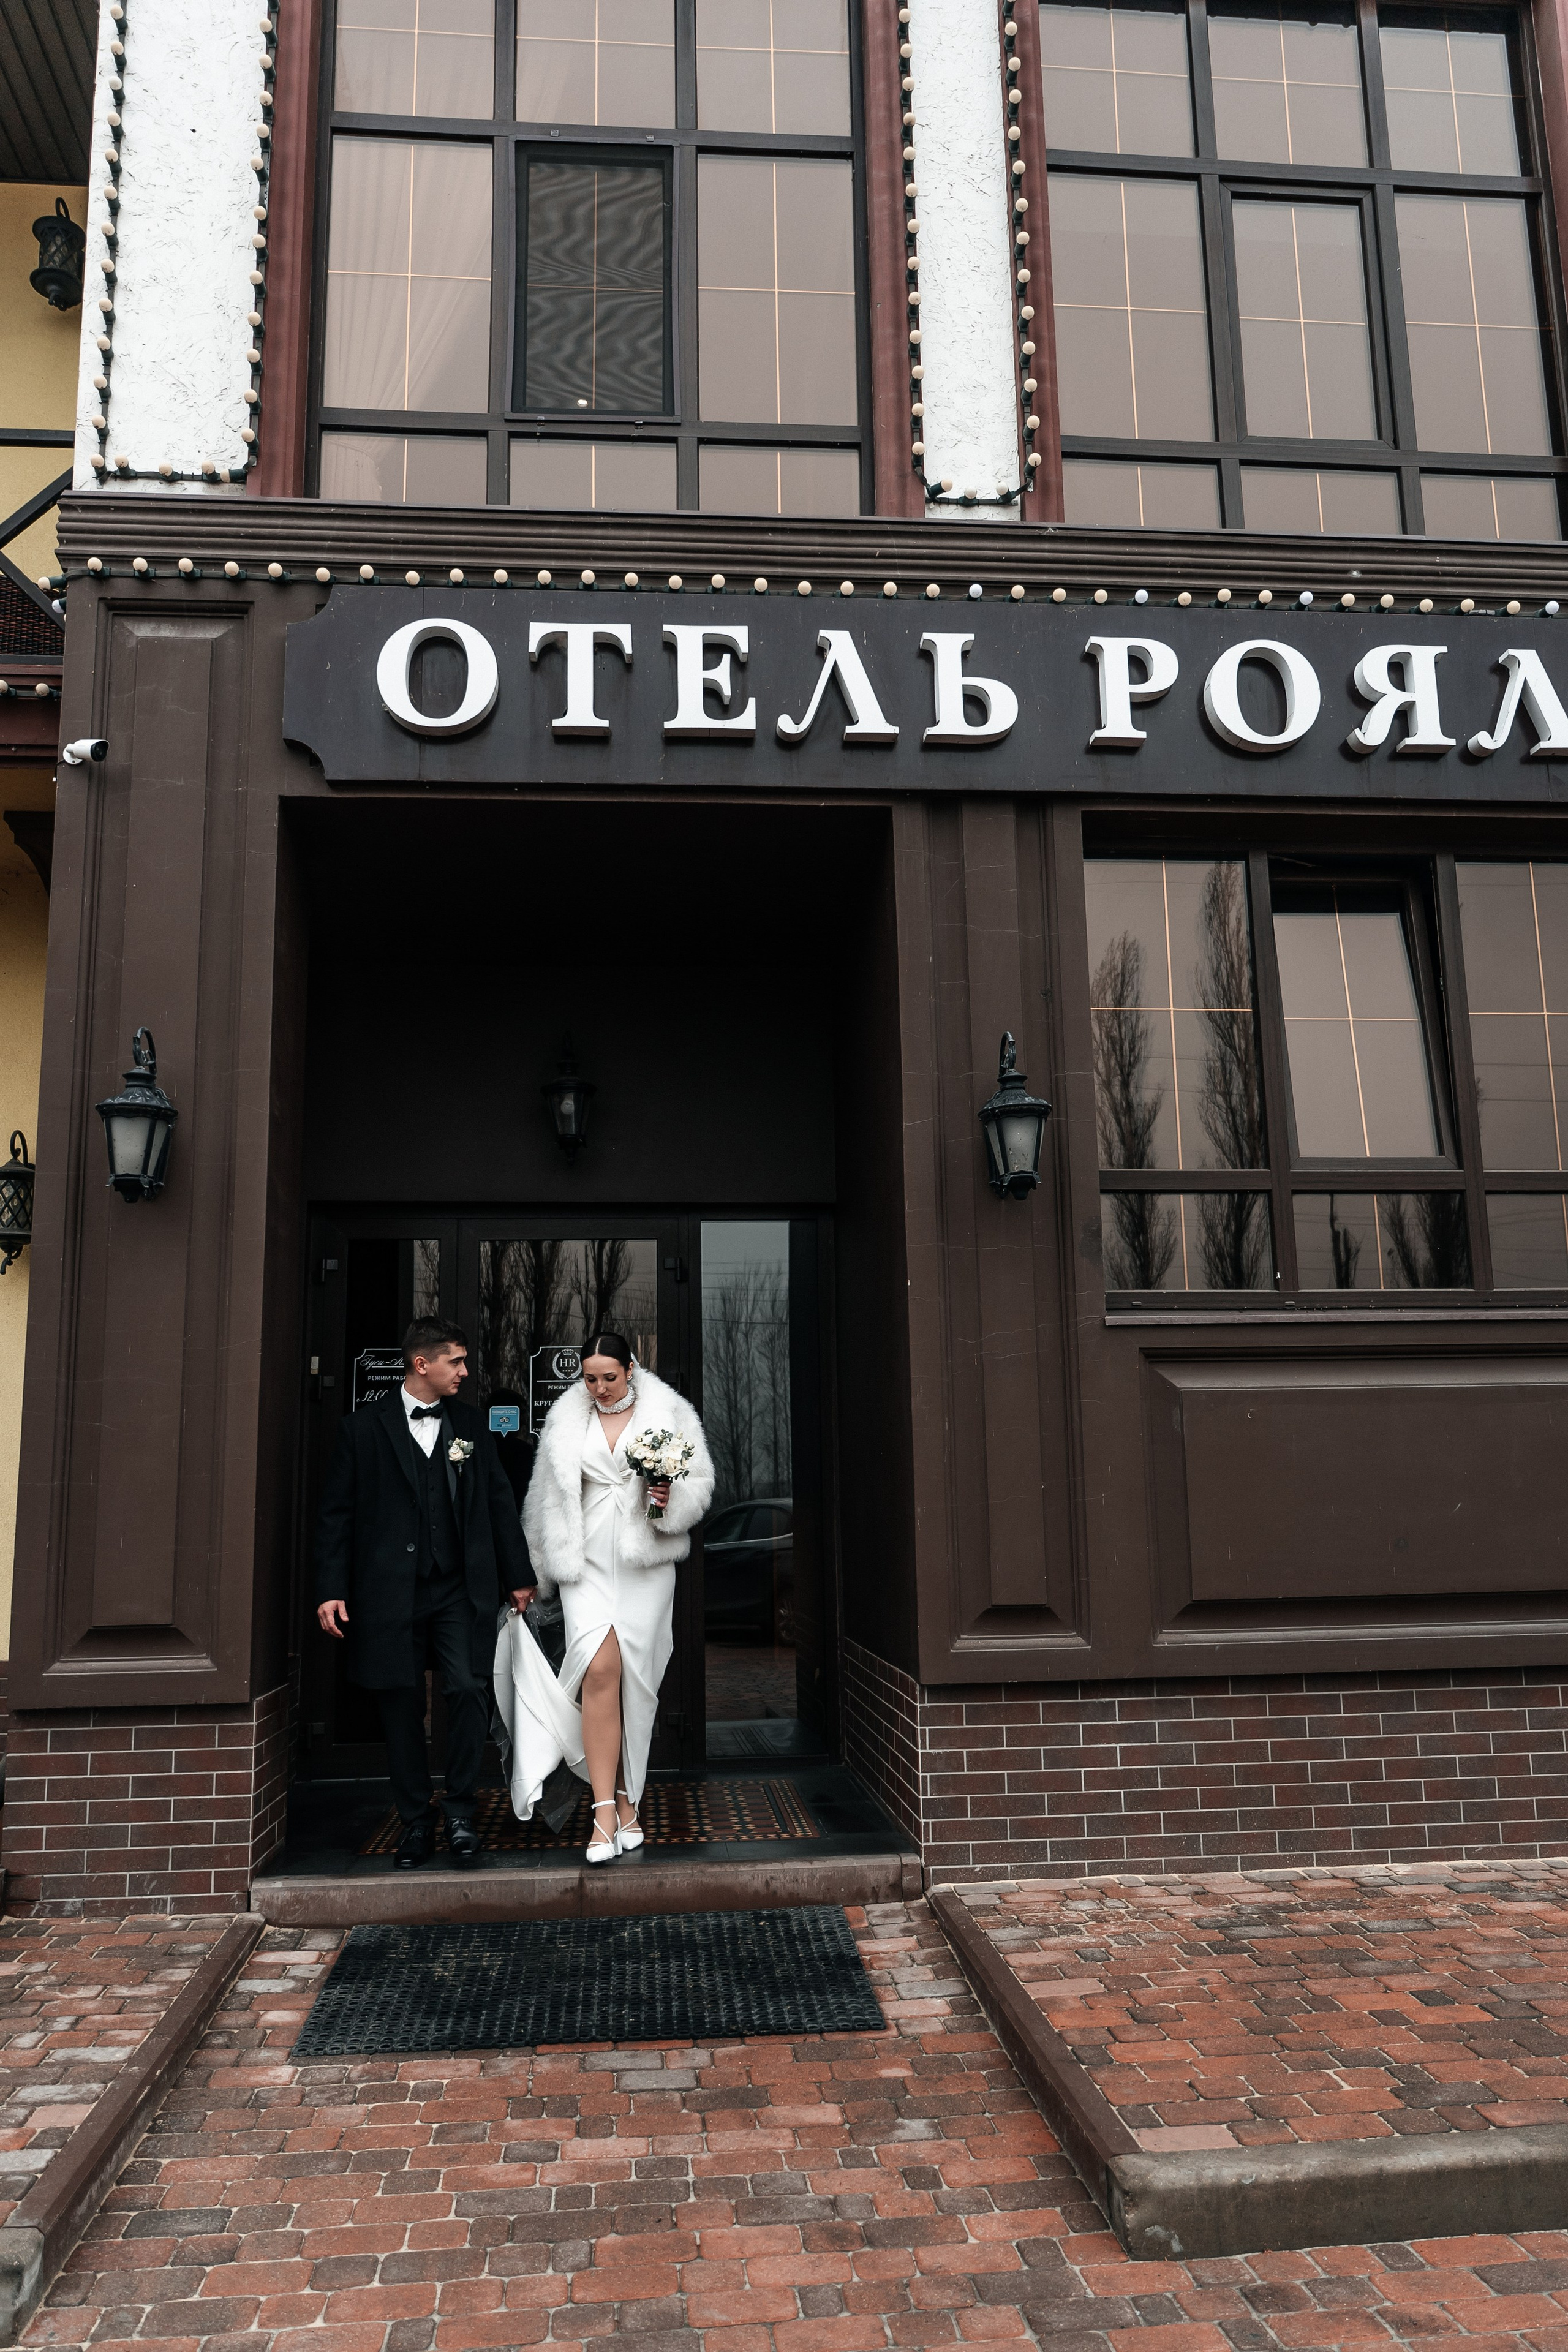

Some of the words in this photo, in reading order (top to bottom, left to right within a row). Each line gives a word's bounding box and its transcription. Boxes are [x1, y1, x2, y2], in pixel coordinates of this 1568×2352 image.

[376, 617, 1020, 744] ОТЕЛЬ
[1084, 635, 1568, 757] РОЯЛ
[559, 1358, 577, 1368] HR
